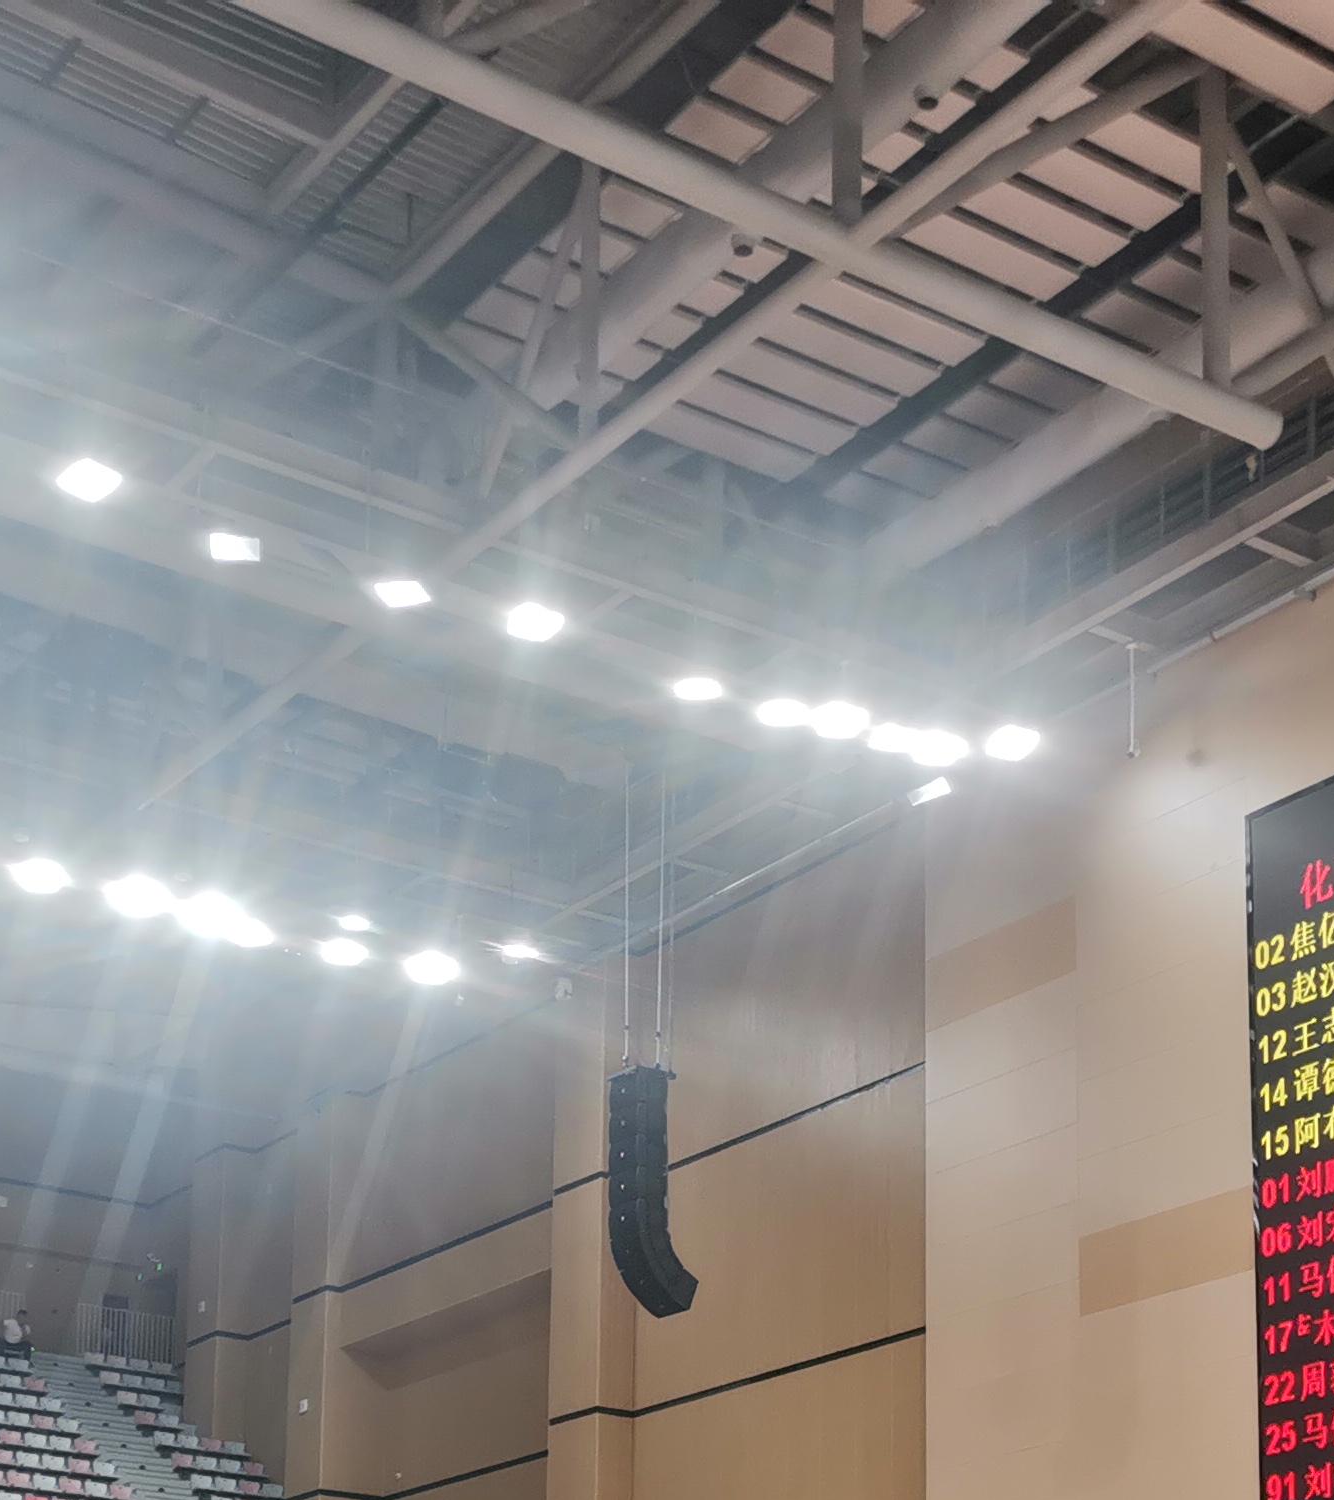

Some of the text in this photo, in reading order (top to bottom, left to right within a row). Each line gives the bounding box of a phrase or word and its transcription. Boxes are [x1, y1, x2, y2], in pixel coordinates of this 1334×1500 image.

[1254, 935, 1286, 969] 02
[1256, 982, 1286, 1016] 03
[1258, 1030, 1287, 1063] 12
[1260, 1078, 1287, 1112] 14
[1261, 1126, 1289, 1160] 15
[1261, 1174, 1290, 1209] 01
[1260, 1225, 1292, 1258] 06
[1263, 1271, 1291, 1306] 11
[1264, 1320, 1294, 1356] 17
[1264, 1372, 1295, 1406] 22
[1265, 1423, 1297, 1456] 25
